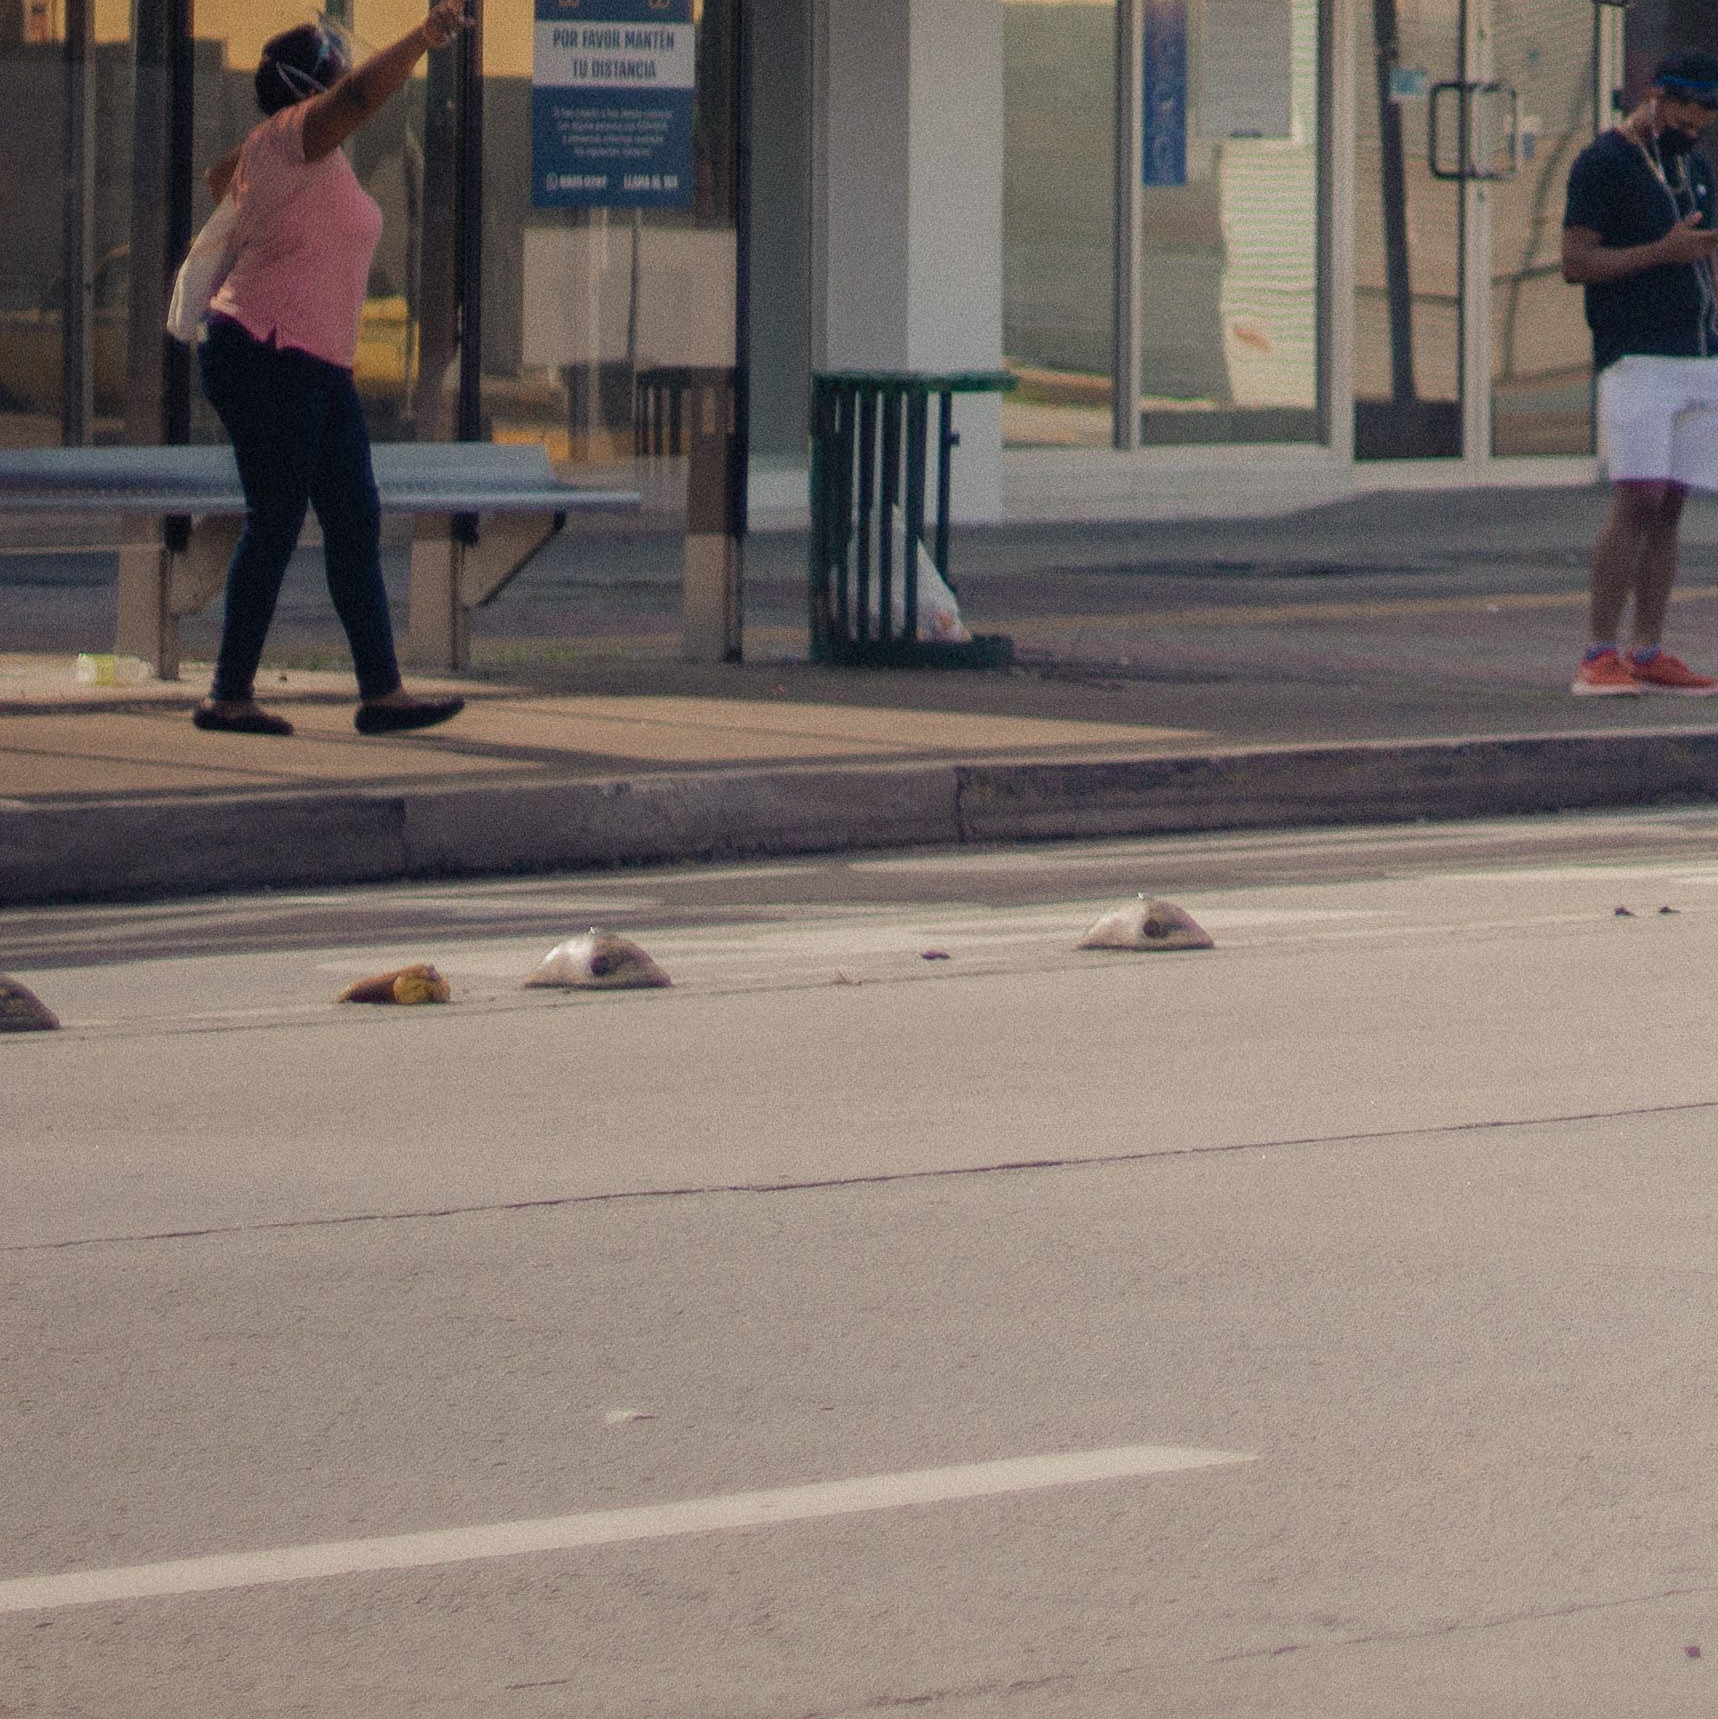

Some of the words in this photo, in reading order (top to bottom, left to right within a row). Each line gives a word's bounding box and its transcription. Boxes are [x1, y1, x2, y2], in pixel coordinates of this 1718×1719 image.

[553, 27, 578, 48] POR
[582, 28, 620, 49] FAVOR
[572, 58, 588, 78] TU
[591, 59, 656, 79] DISTANCIA
